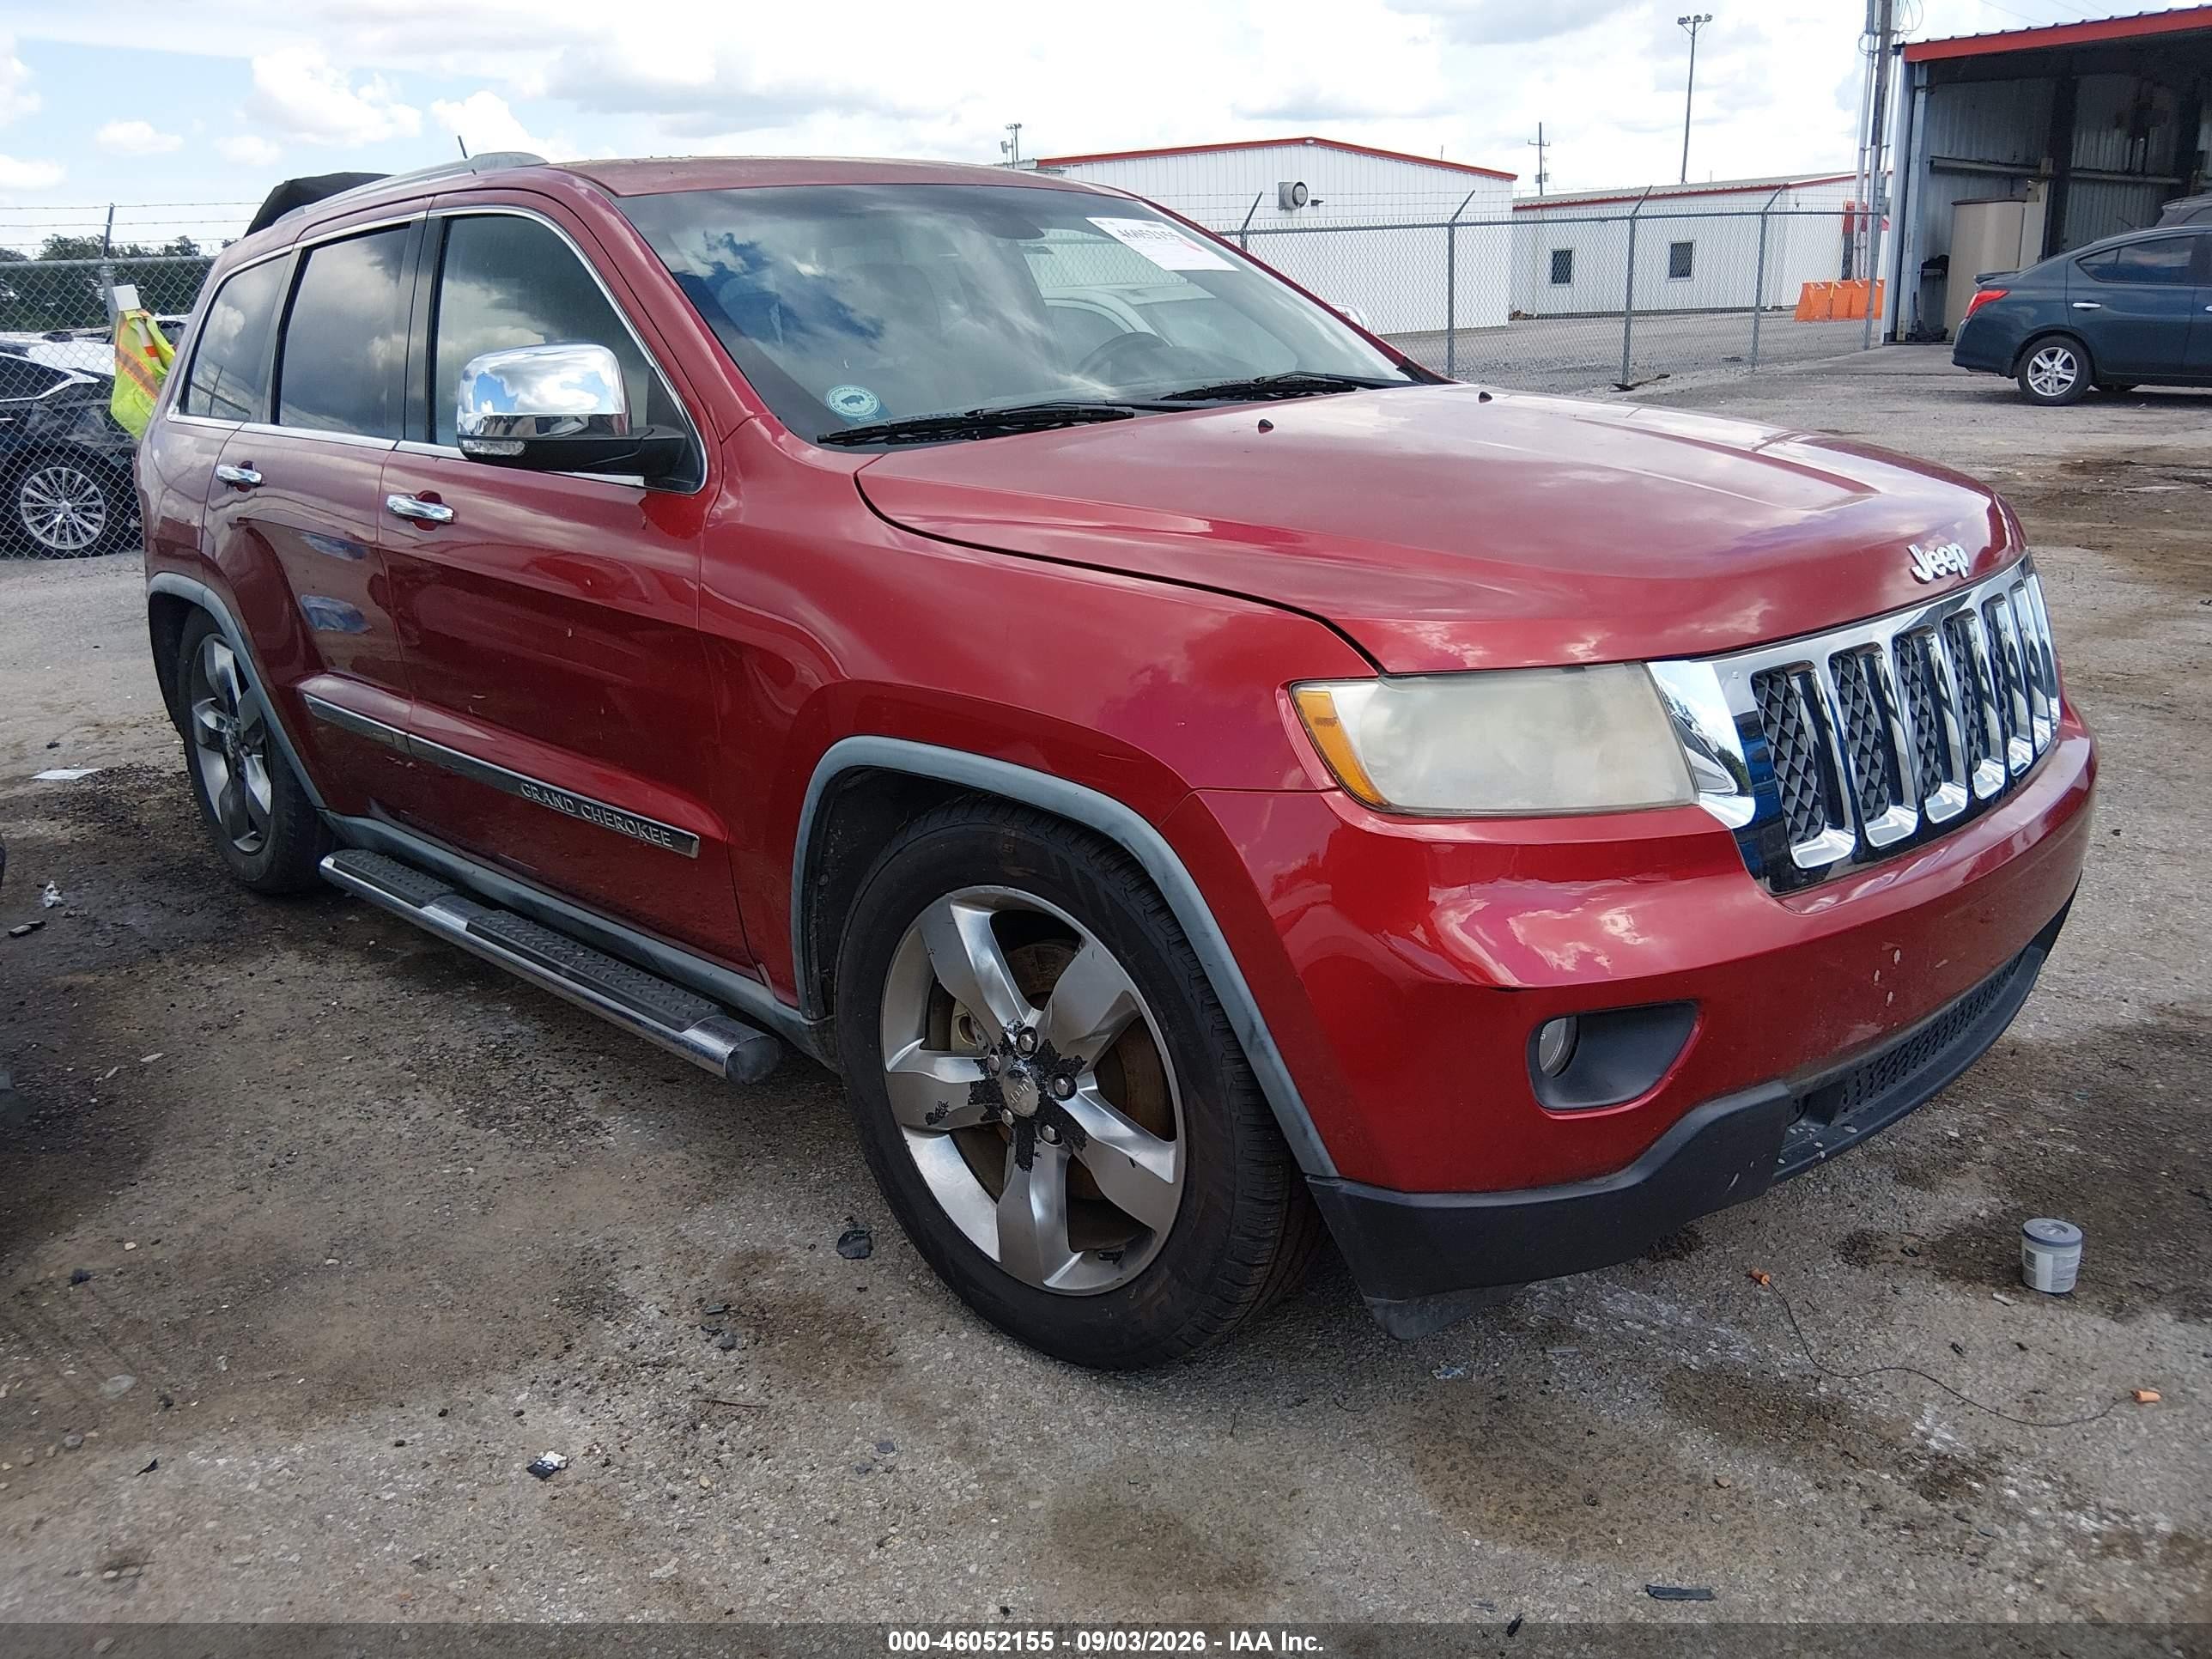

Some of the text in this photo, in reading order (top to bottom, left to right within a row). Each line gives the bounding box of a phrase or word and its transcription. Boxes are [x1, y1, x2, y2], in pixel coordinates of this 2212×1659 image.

[1906, 543, 1969, 583] Jeep
[521, 783, 673, 848] GRAND CHEROKEE
[1010, 1079, 1030, 1104] Jeep
